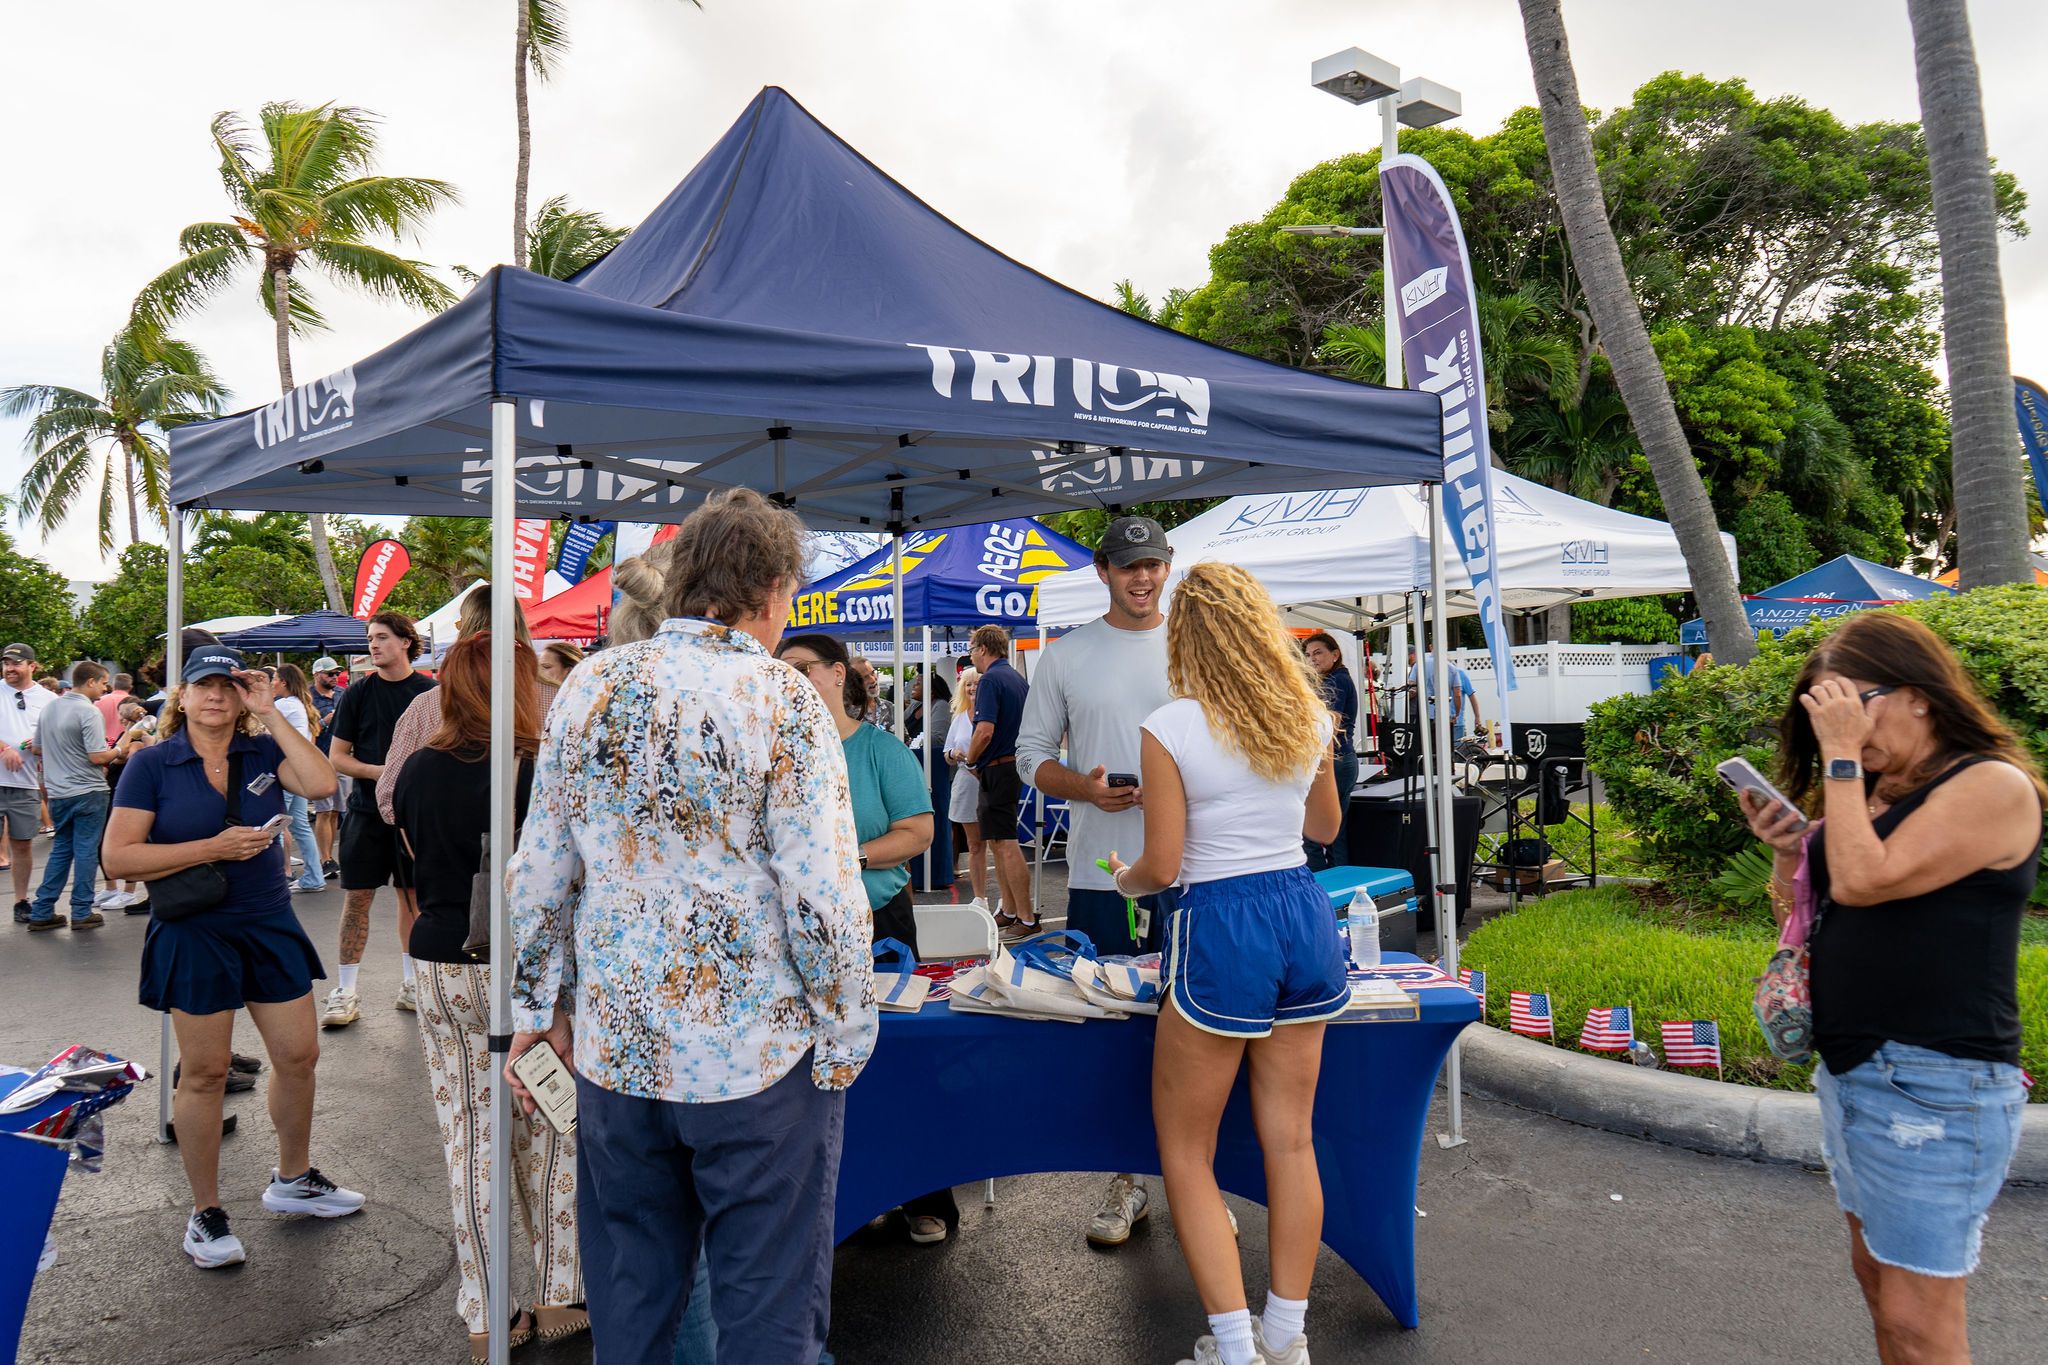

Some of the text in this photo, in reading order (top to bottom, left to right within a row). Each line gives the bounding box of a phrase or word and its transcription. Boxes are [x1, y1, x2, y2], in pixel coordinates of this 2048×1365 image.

[1460, 329, 1475, 398] Sold Here
[905, 343, 1211, 427] TRITON
[1074, 413, 1092, 421] NEWS
[1098, 416, 1137, 427] NETWORKING
[1150, 423, 1177, 432] CAPTAINS
[1219, 487, 1371, 535] KVH
[1203, 524, 1341, 549] SUPERYACHT GROUP
[1560, 539, 1608, 565] KVH
[356, 543, 396, 618] YANMAR
[1751, 602, 1864, 618] ANDERSON
